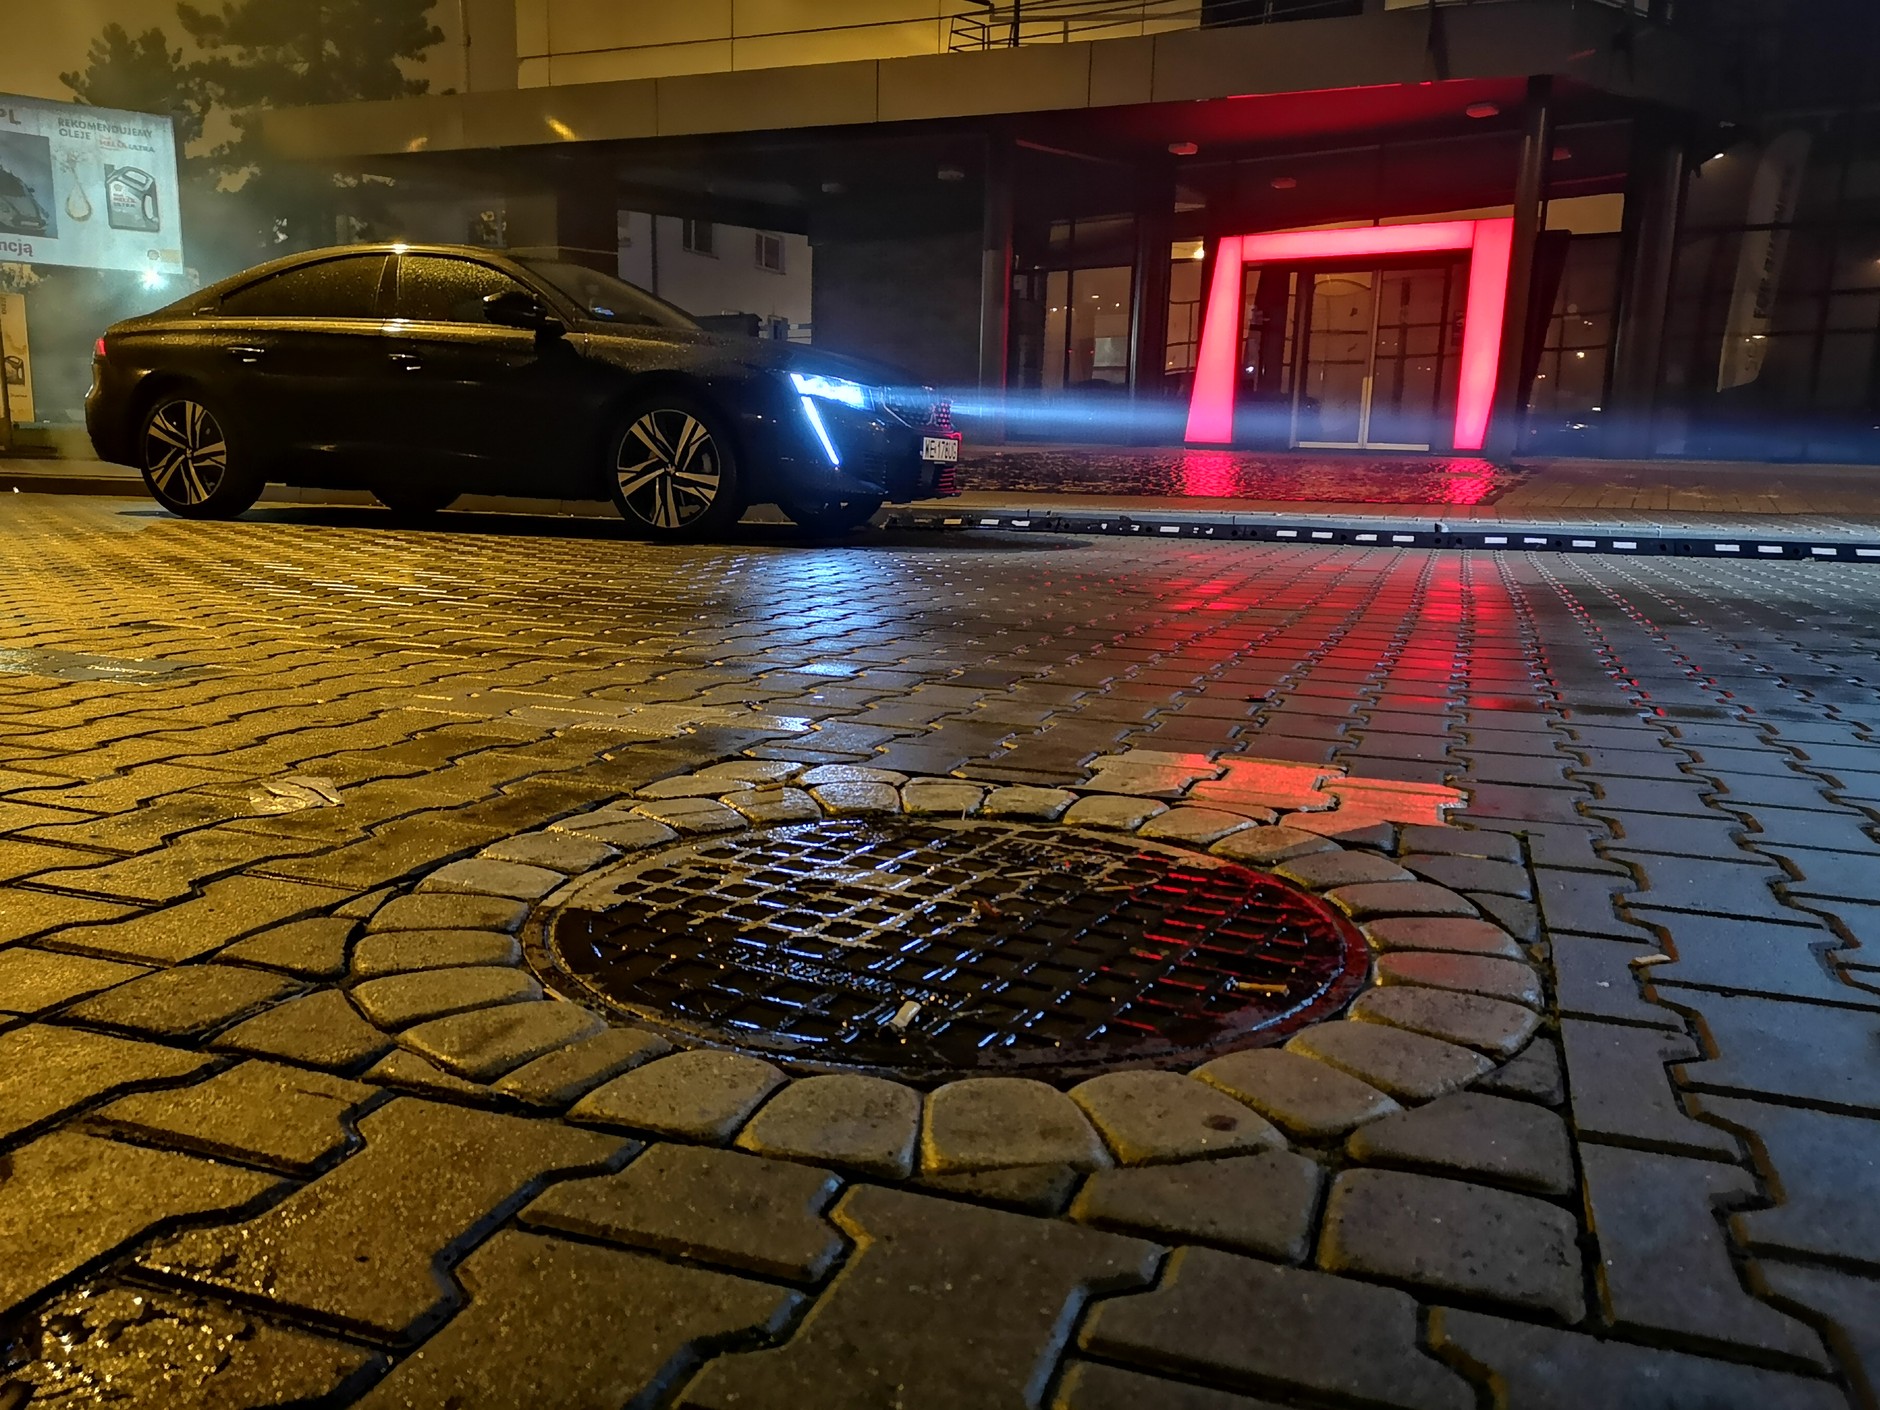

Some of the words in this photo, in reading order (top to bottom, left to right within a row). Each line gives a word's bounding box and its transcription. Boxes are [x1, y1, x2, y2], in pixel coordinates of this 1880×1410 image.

[58, 118, 153, 137] REKOMENDUJEMY
[59, 128, 92, 140] OLEJE
[0, 239, 33, 257] ncją
